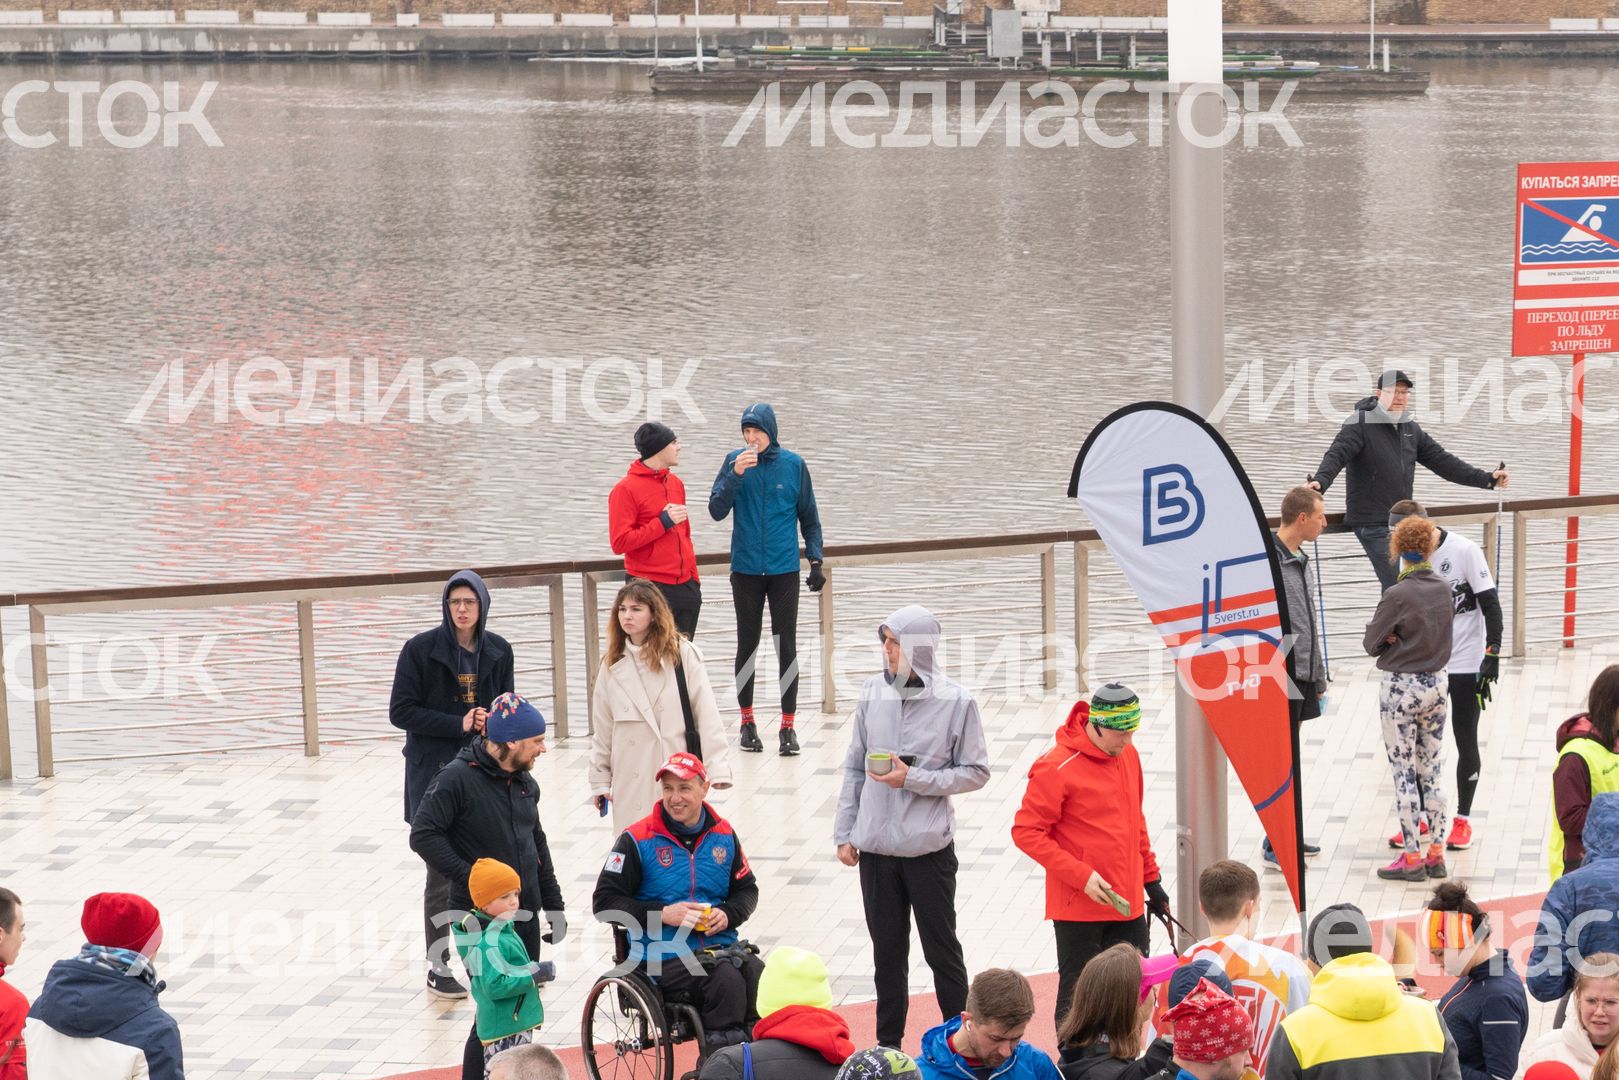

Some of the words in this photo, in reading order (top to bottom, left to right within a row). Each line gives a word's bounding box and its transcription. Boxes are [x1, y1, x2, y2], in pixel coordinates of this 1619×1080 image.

[1521, 176, 1579, 189] КУПАТЬСЯ
[1528, 311, 1579, 324] ПЕРЕХОД
[1557, 325, 1575, 337] ПО
[1576, 324, 1606, 337] ЛЬДУ
[1550, 338, 1612, 352] ЗАПРЕЩЕН
[1214, 607, 1260, 624] 5verst.ru
